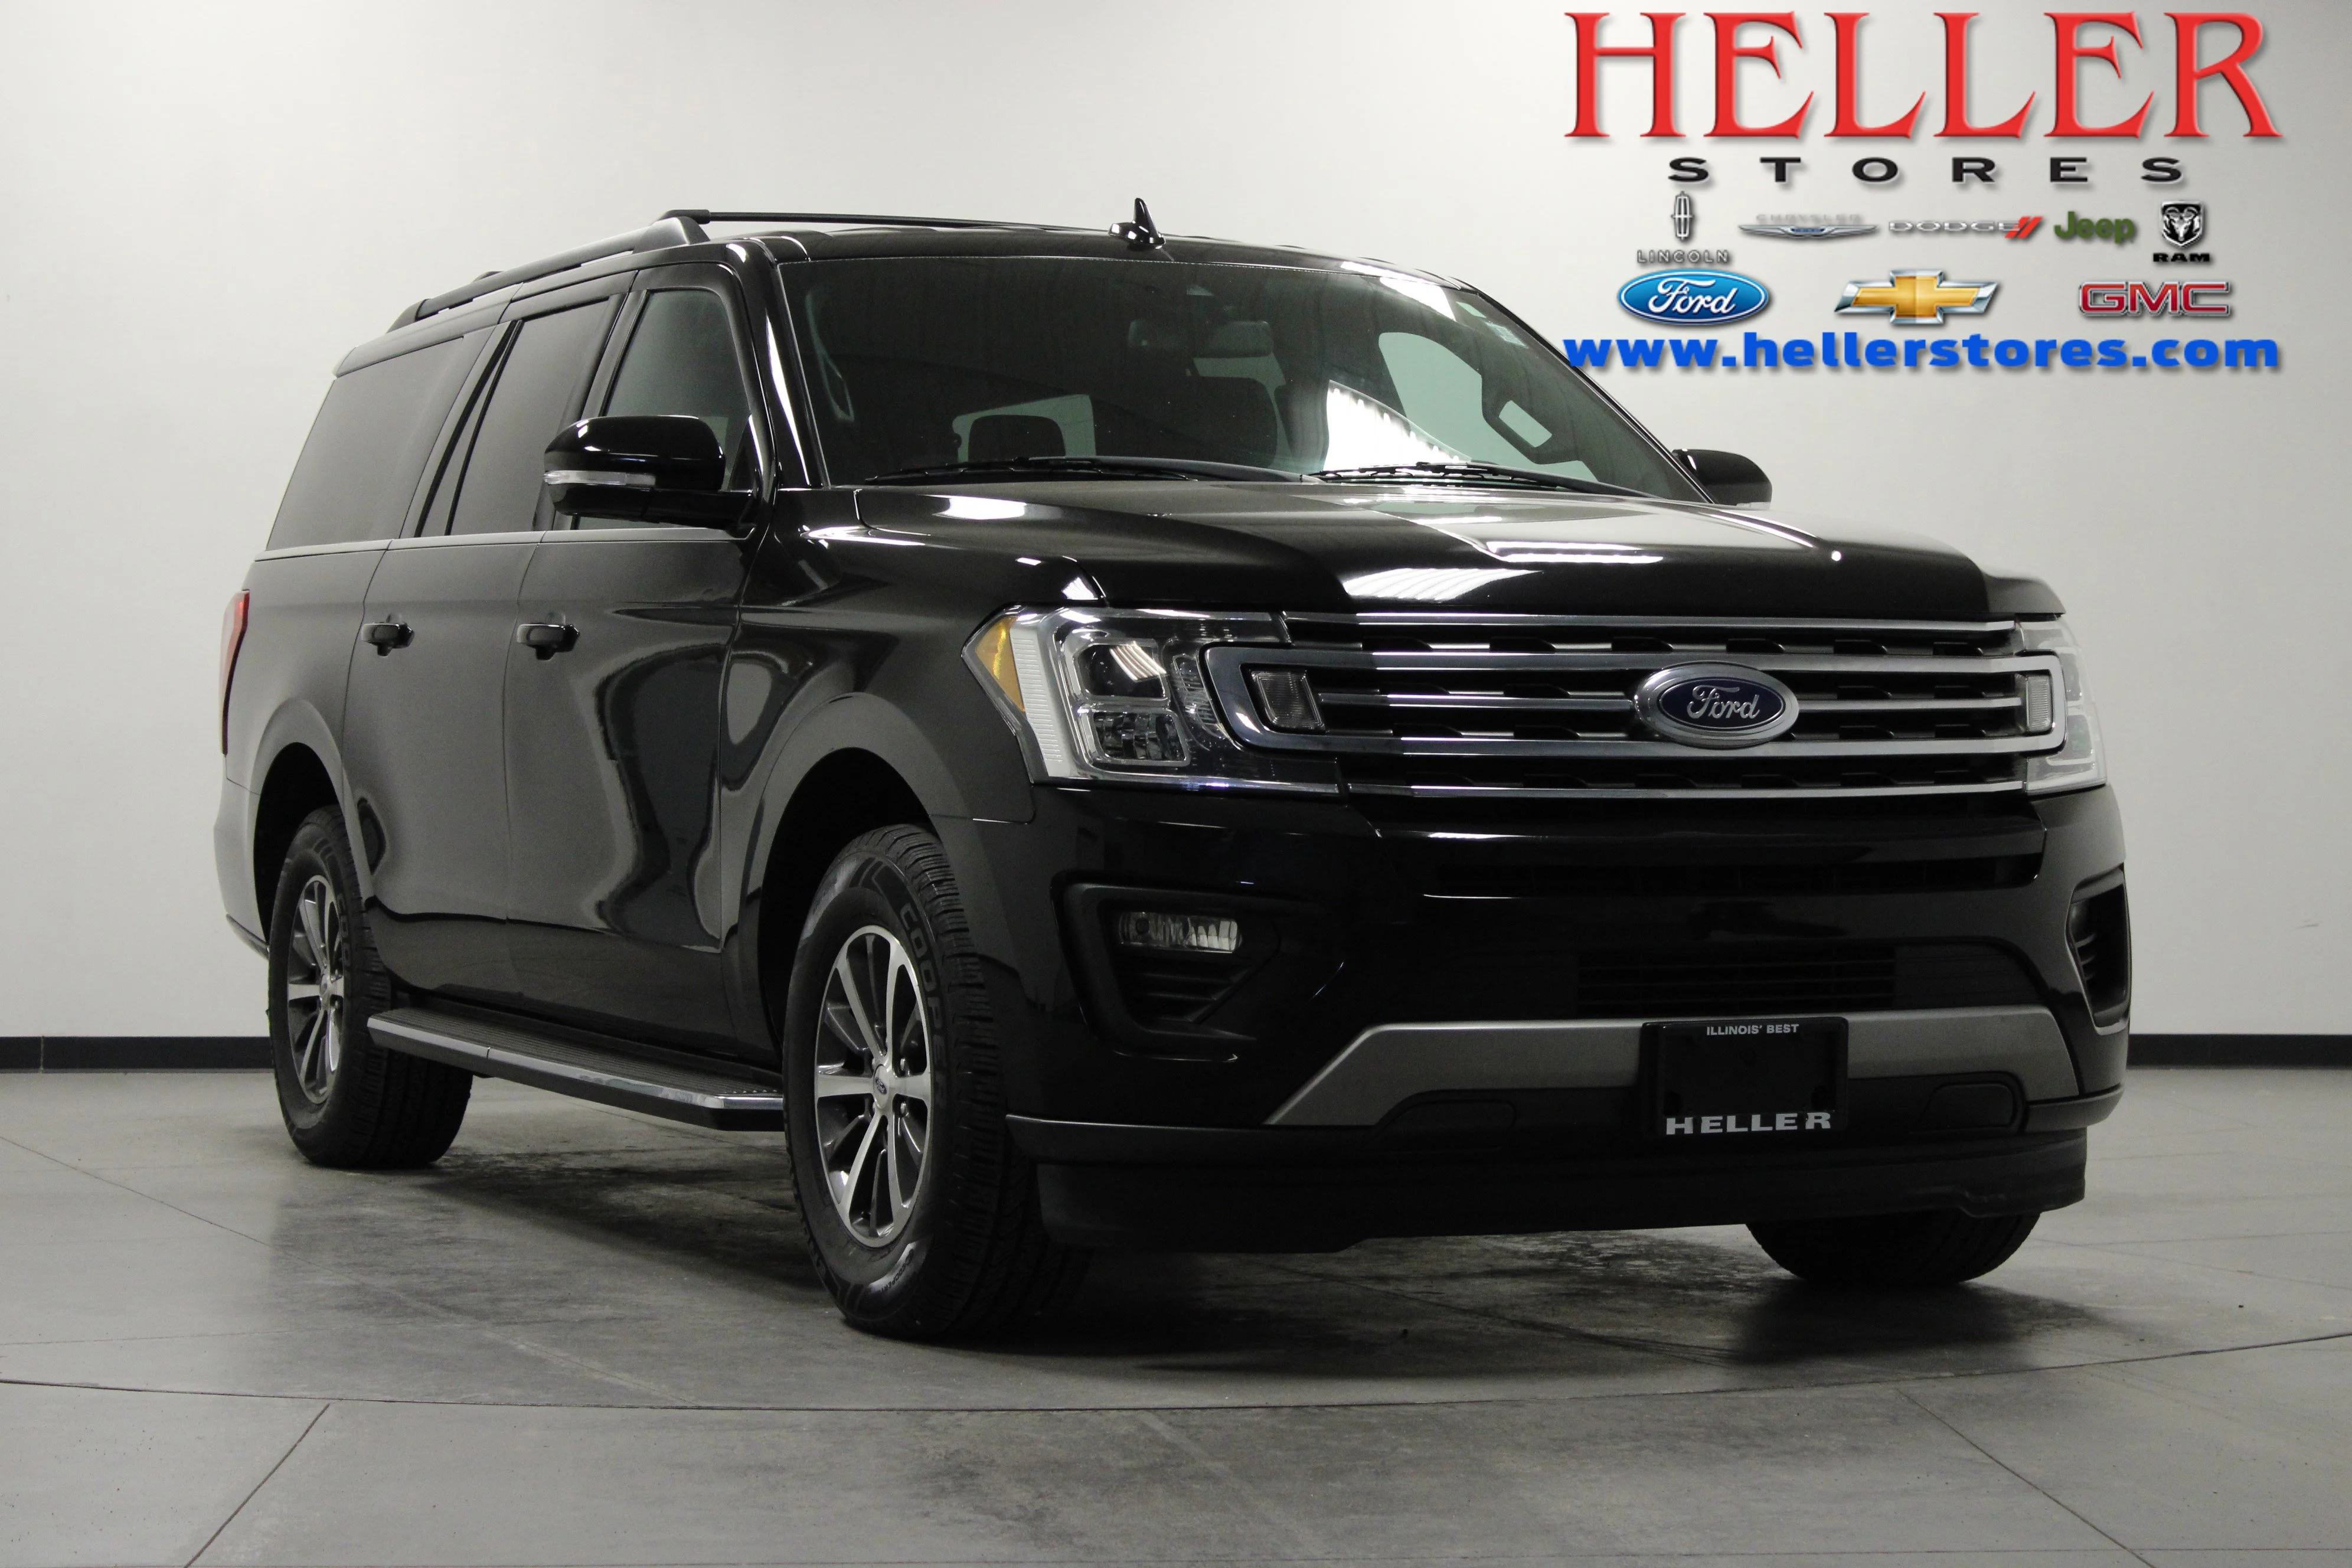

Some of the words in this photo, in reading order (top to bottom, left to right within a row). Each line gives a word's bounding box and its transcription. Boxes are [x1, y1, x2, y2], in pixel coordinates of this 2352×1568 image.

[1687, 685, 1760, 719] Ford
[899, 902, 948, 1109] COOPER
[1766, 1024, 1799, 1034] BEST
[1665, 1112, 1831, 1135] HELLER
